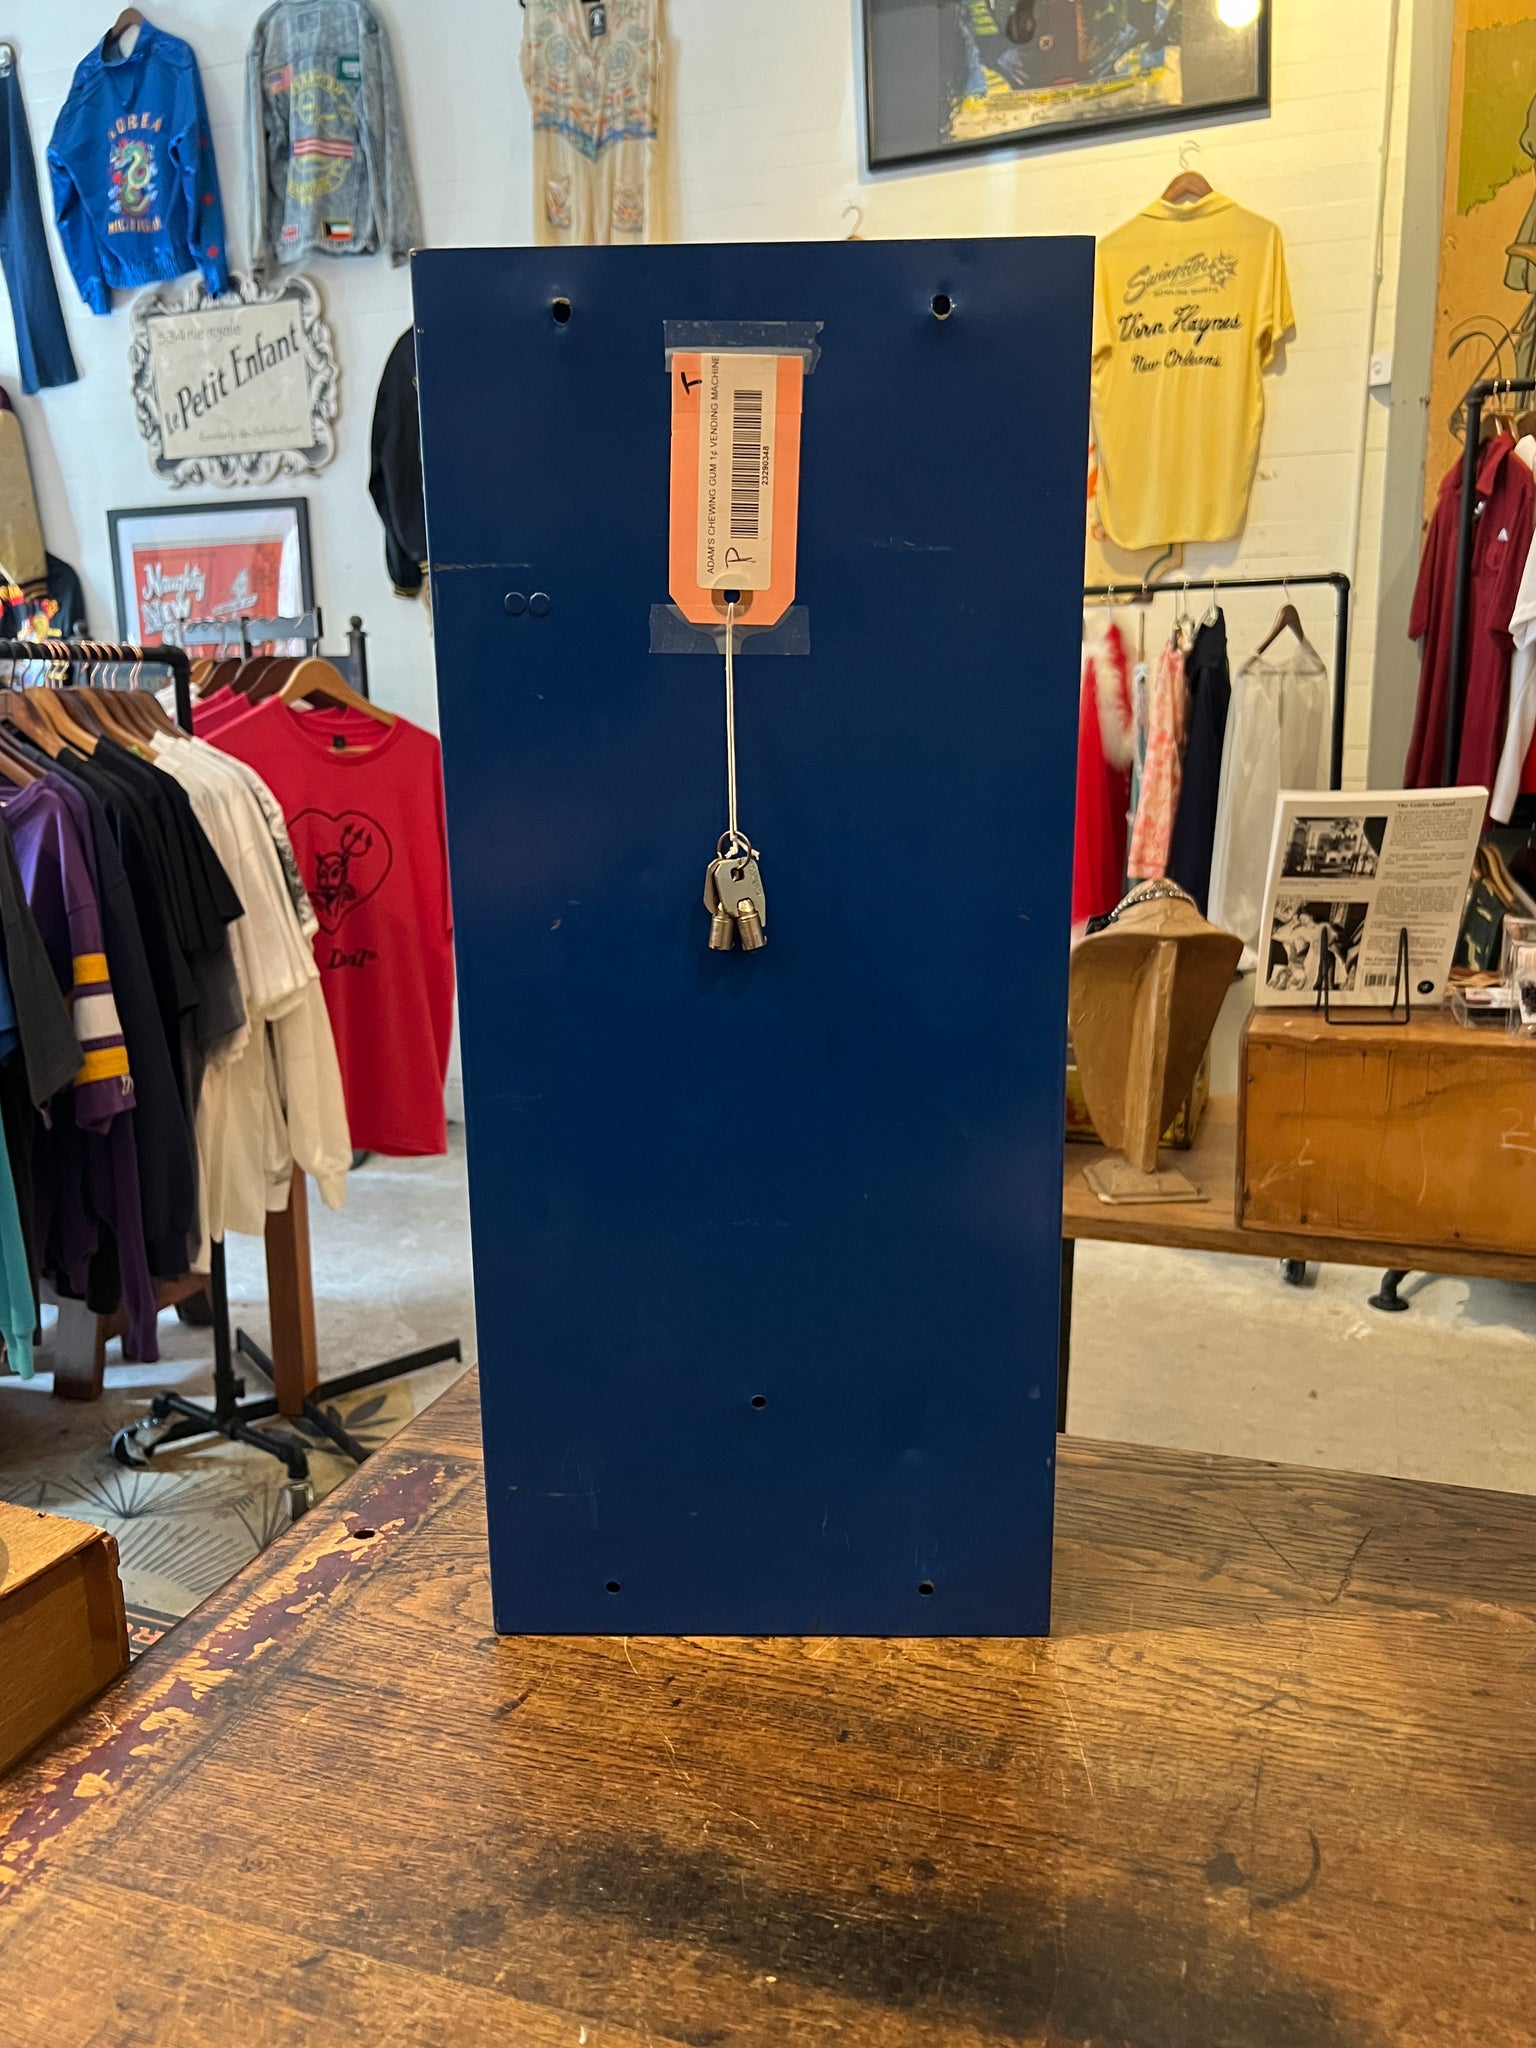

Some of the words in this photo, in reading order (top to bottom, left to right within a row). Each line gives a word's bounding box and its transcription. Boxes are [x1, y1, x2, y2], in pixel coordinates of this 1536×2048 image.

[176, 371, 228, 430] Petit
[230, 320, 300, 390] Enfant
[710, 355, 720, 400] MACHINE
[1131, 352, 1161, 374] New
[1164, 348, 1223, 369] Orleans
[709, 402, 719, 448] VENDING
[708, 463, 718, 487] GUM
[761, 445, 770, 486] 23290348
[707, 488, 717, 536] CHEWING
[706, 537, 716, 575] ADAM'S
